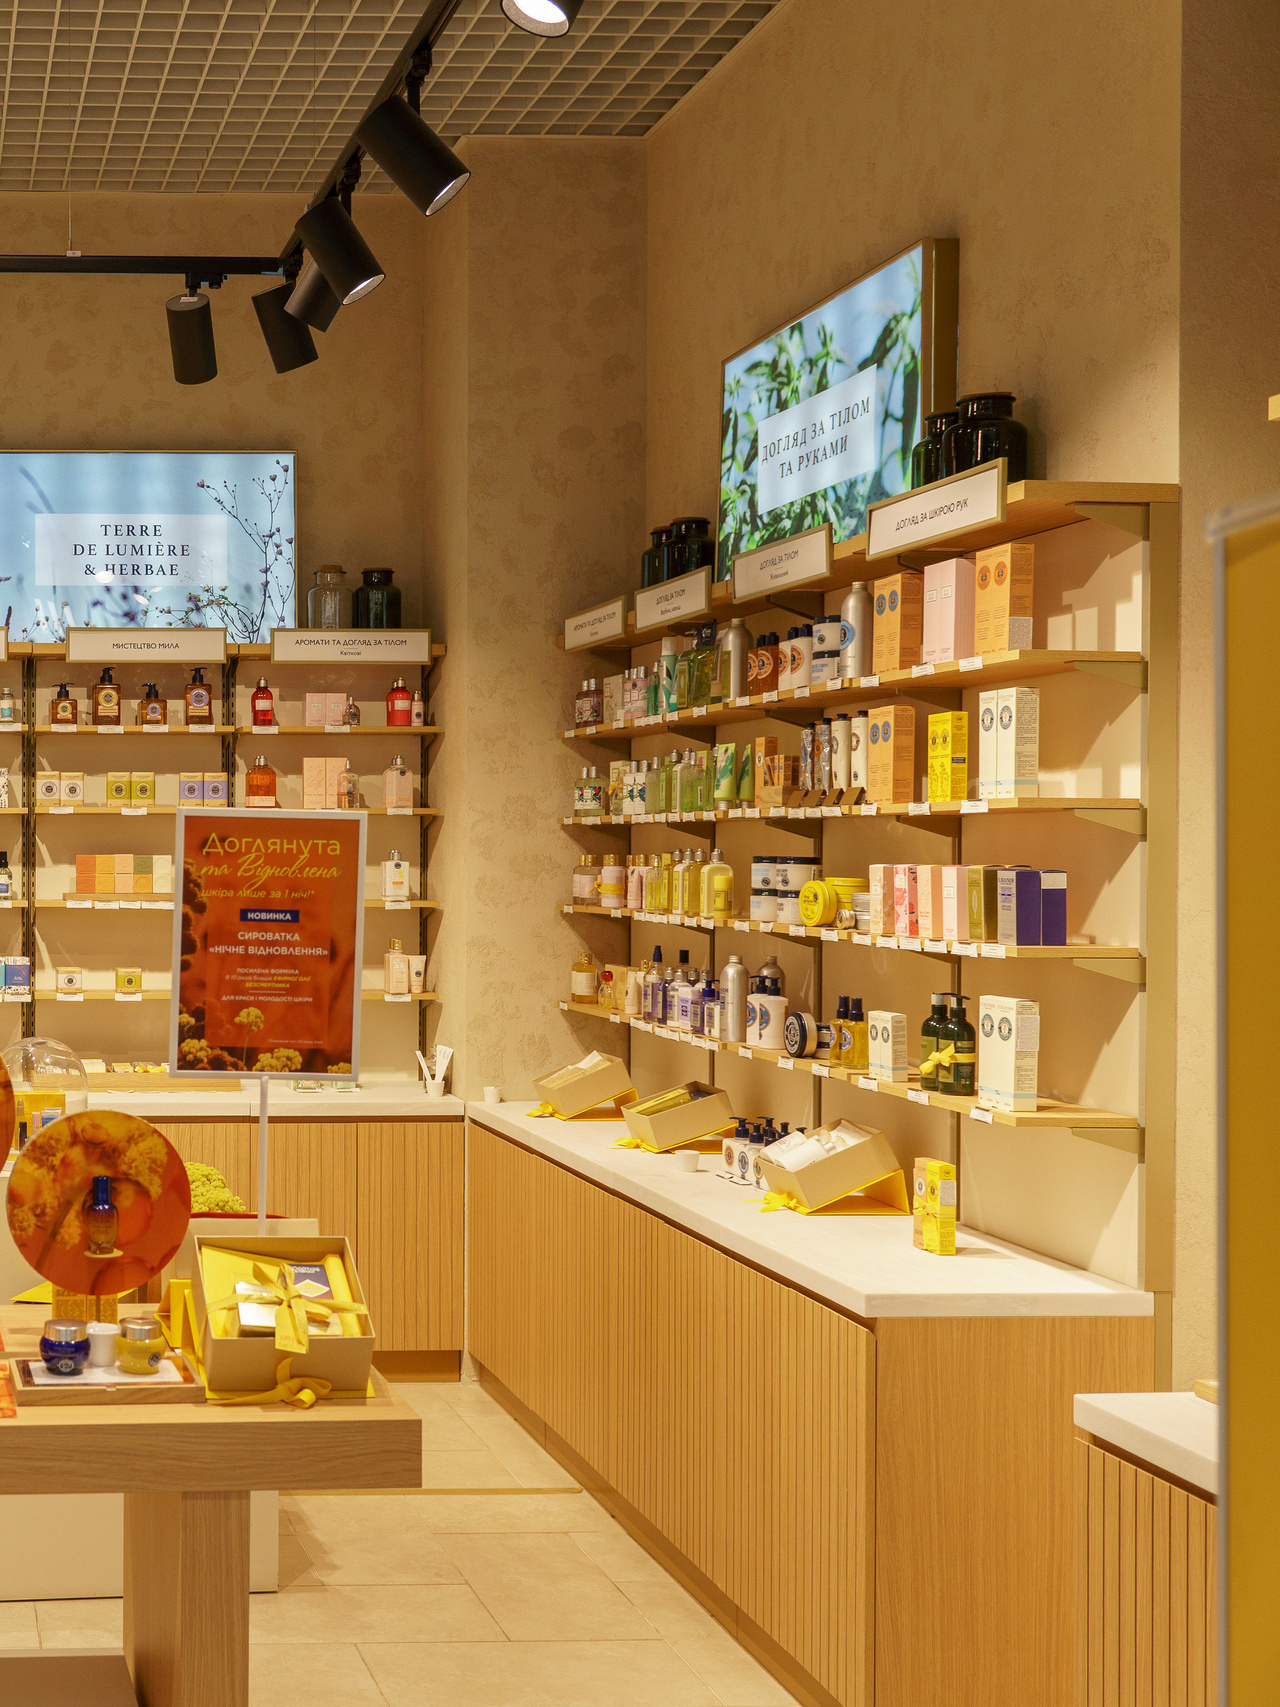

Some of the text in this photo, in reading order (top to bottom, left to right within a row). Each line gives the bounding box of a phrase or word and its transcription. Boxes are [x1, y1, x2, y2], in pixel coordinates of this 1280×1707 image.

[762, 396, 870, 465] ДОГЛЯД ЗА ТІЛОМ
[780, 434, 848, 478] ТА РУКАМИ
[895, 498, 969, 532] ДОГЛЯД ЗА ШКІРОЮ РУК
[100, 524, 163, 537] TERRE
[72, 541, 191, 556] DE LUMIÈRE
[760, 550, 799, 571] ДОГЛЯД ЗА ТІЛОМ
[84, 564, 180, 576] & HERBAE
[202, 833, 340, 858] Доглянута
[200, 852, 342, 892] та Відновлена
[201, 888, 234, 898] шкіра
[236, 890, 266, 898] лише
[284, 890, 288, 898] 1
[248, 912, 292, 920] НОВИНКА
[237, 932, 300, 941] СИРОВАТКА
[209, 945, 328, 956] «НІЧНЕ ВІДНОВЛЕННЯ»
